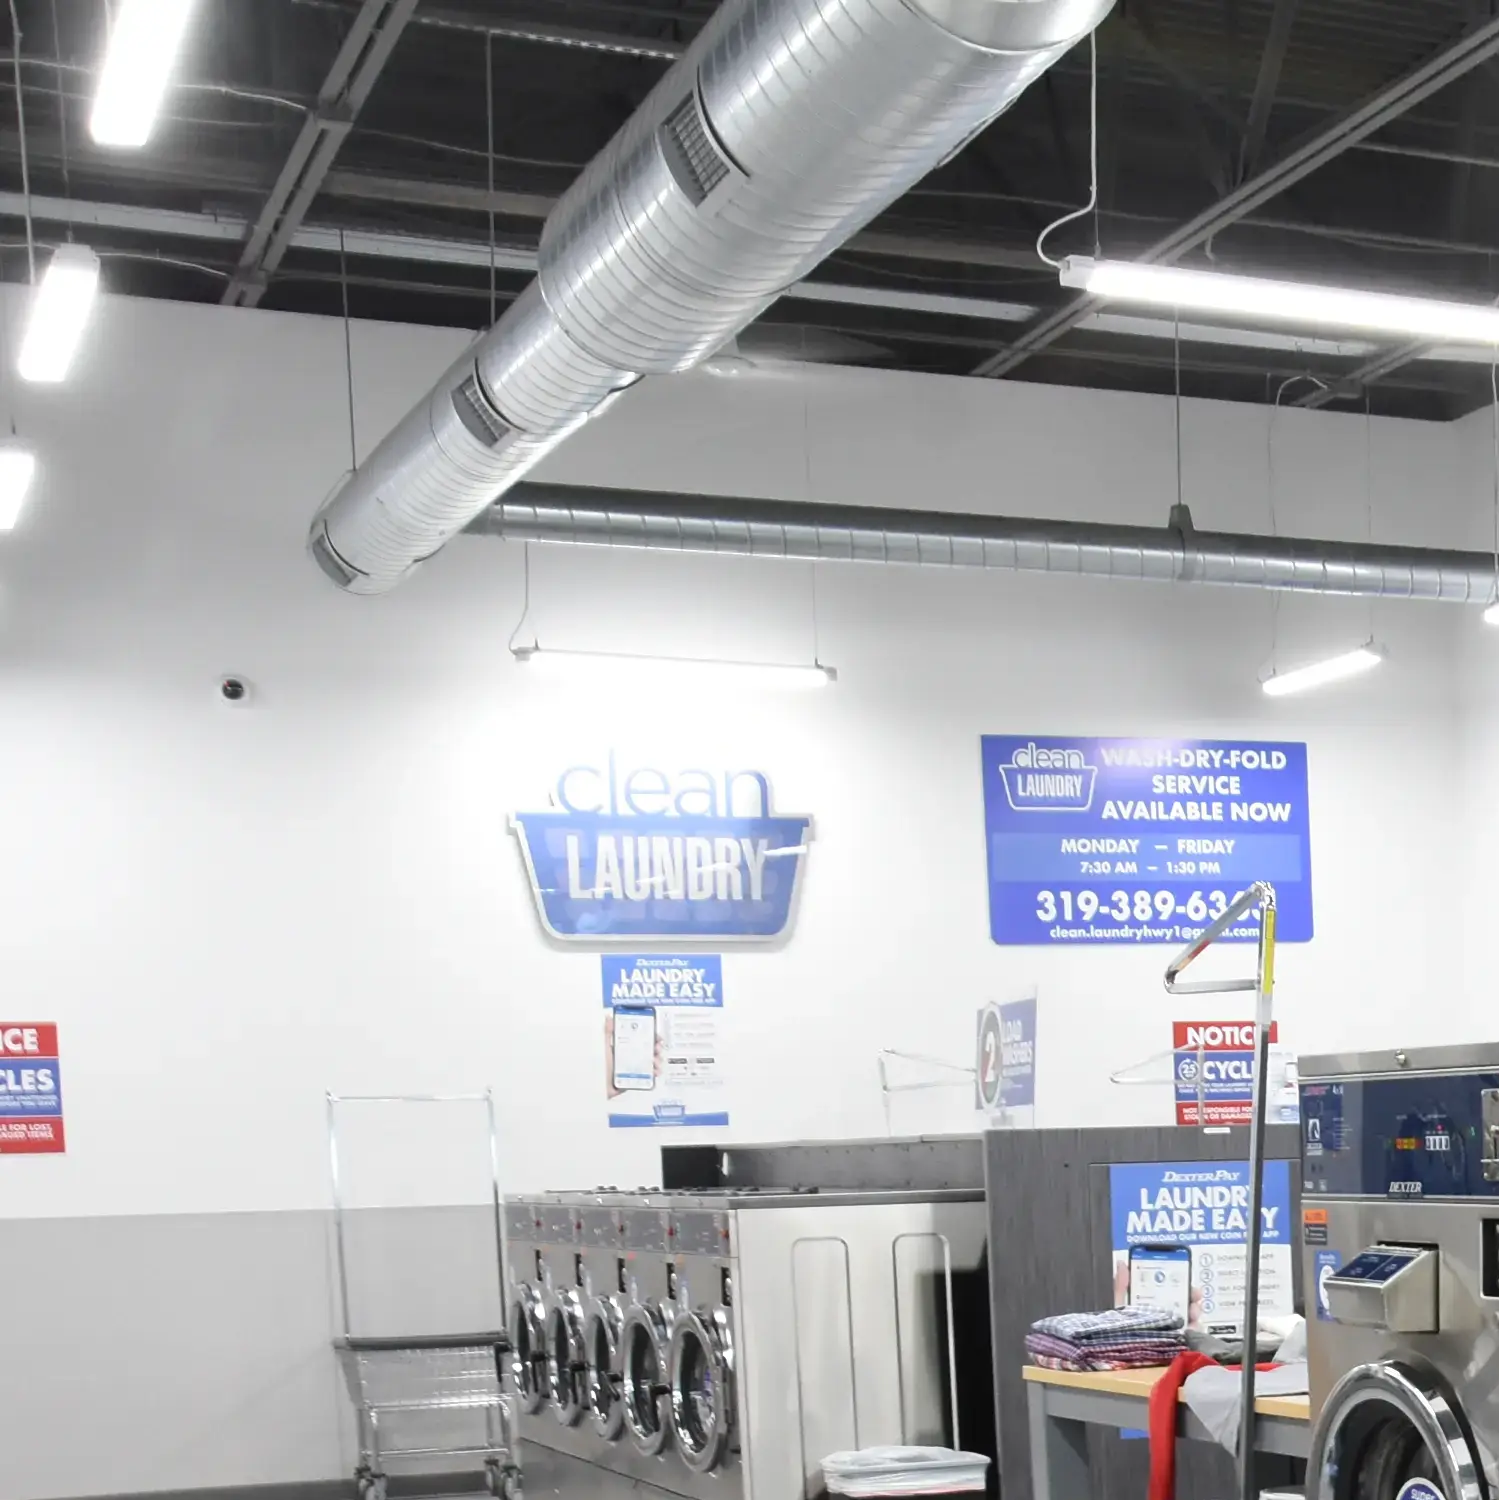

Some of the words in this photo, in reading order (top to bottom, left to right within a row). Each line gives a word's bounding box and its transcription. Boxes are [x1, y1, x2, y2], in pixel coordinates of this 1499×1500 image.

[1012, 742, 1085, 769] clean
[1101, 747, 1288, 769] WASH-DRY-FOLD
[556, 749, 770, 818] clean
[1016, 774, 1083, 799] LAUNDRY
[1151, 774, 1241, 795] SERVICE
[1101, 800, 1224, 821] AVAILABLE
[1230, 803, 1291, 822] NOW
[1060, 838, 1140, 854] MONDAY
[1177, 839, 1236, 855] FRIDAY
[565, 834, 769, 901] LAUNDRY
[1080, 861, 1112, 875] 7:30
[1114, 861, 1138, 875] AM
[1166, 861, 1196, 875] 1:30
[1199, 861, 1221, 875] PM
[1035, 890, 1261, 922] 319-389-63
[620, 968, 706, 984] LAUNDRY
[611, 982, 665, 998] MADE
[669, 982, 717, 998] EASY
[1186, 1026, 1257, 1046] NOTIC
[984, 1031, 996, 1083] 2
[1389, 1181, 1423, 1193] DEXTER
[1126, 1209, 1206, 1234] MADE
[1212, 1206, 1279, 1231] EAY
[1126, 1233, 1178, 1244] DOWNLOAD
[1178, 1232, 1198, 1241] OUR
[1199, 1232, 1219, 1240] NEW
[1220, 1231, 1242, 1240] COIN
